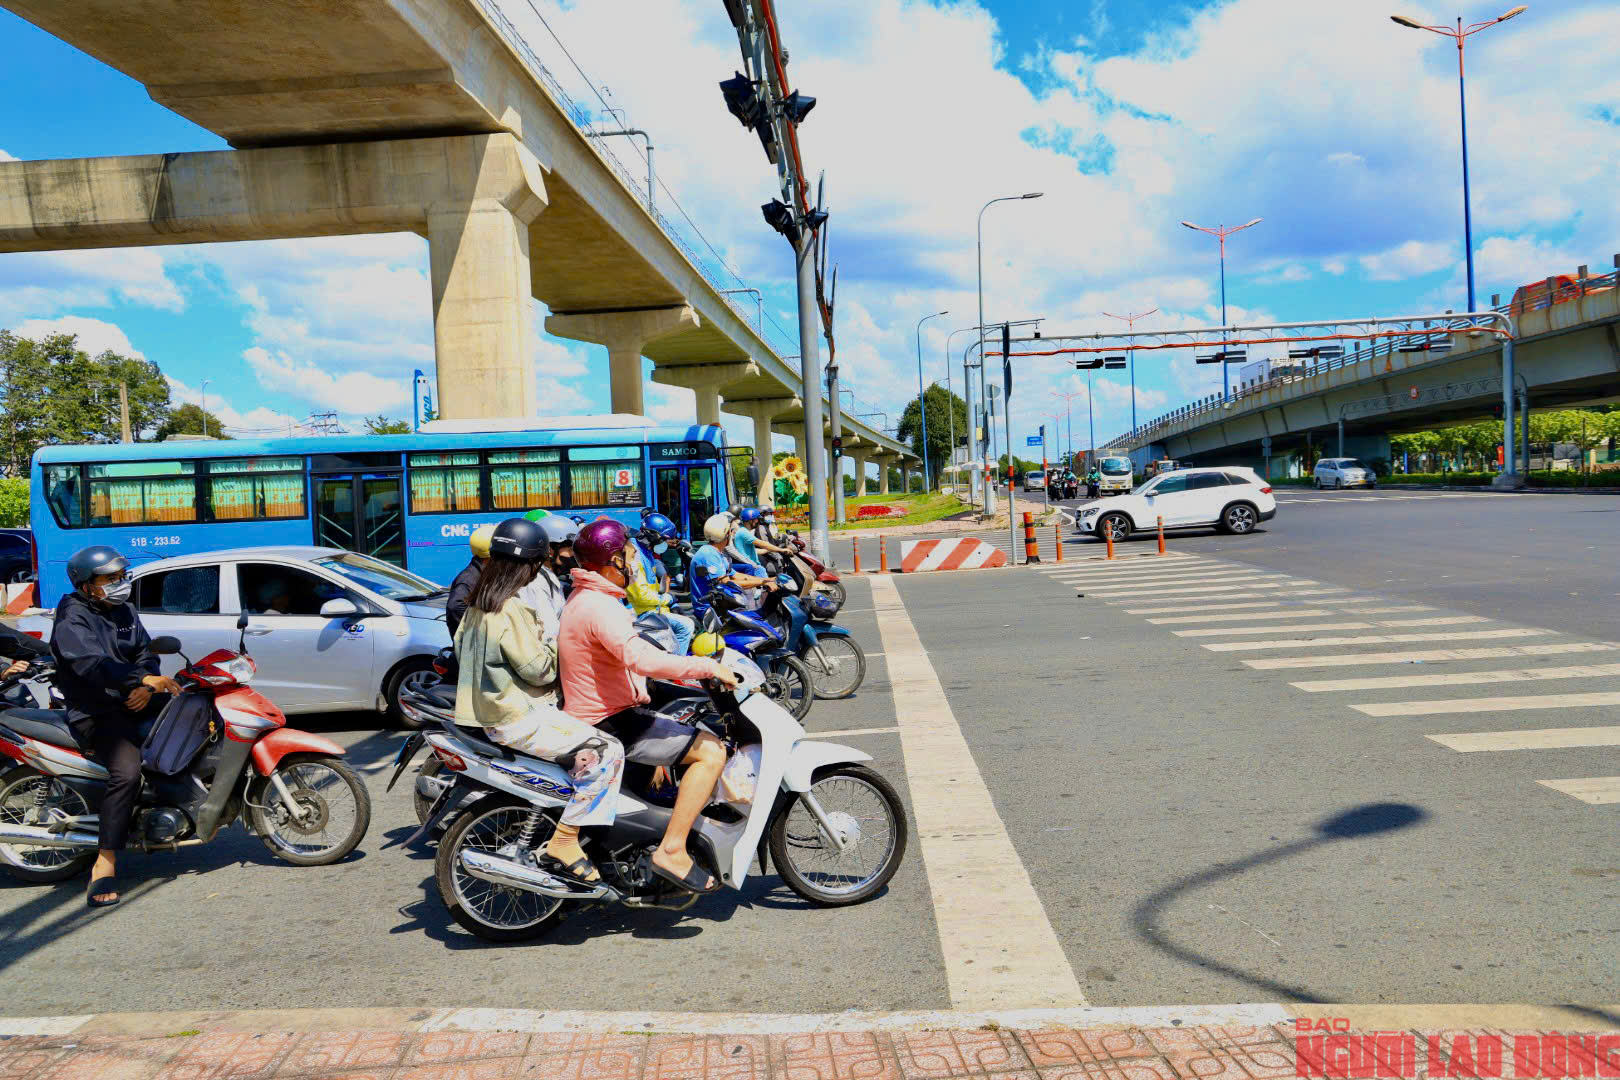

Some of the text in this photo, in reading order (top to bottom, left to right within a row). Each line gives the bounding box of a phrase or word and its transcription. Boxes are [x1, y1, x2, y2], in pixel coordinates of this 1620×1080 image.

[661, 447, 697, 456] SAMCO
[618, 470, 629, 485] 8
[441, 523, 470, 537] CNG
[131, 537, 147, 547] 51B
